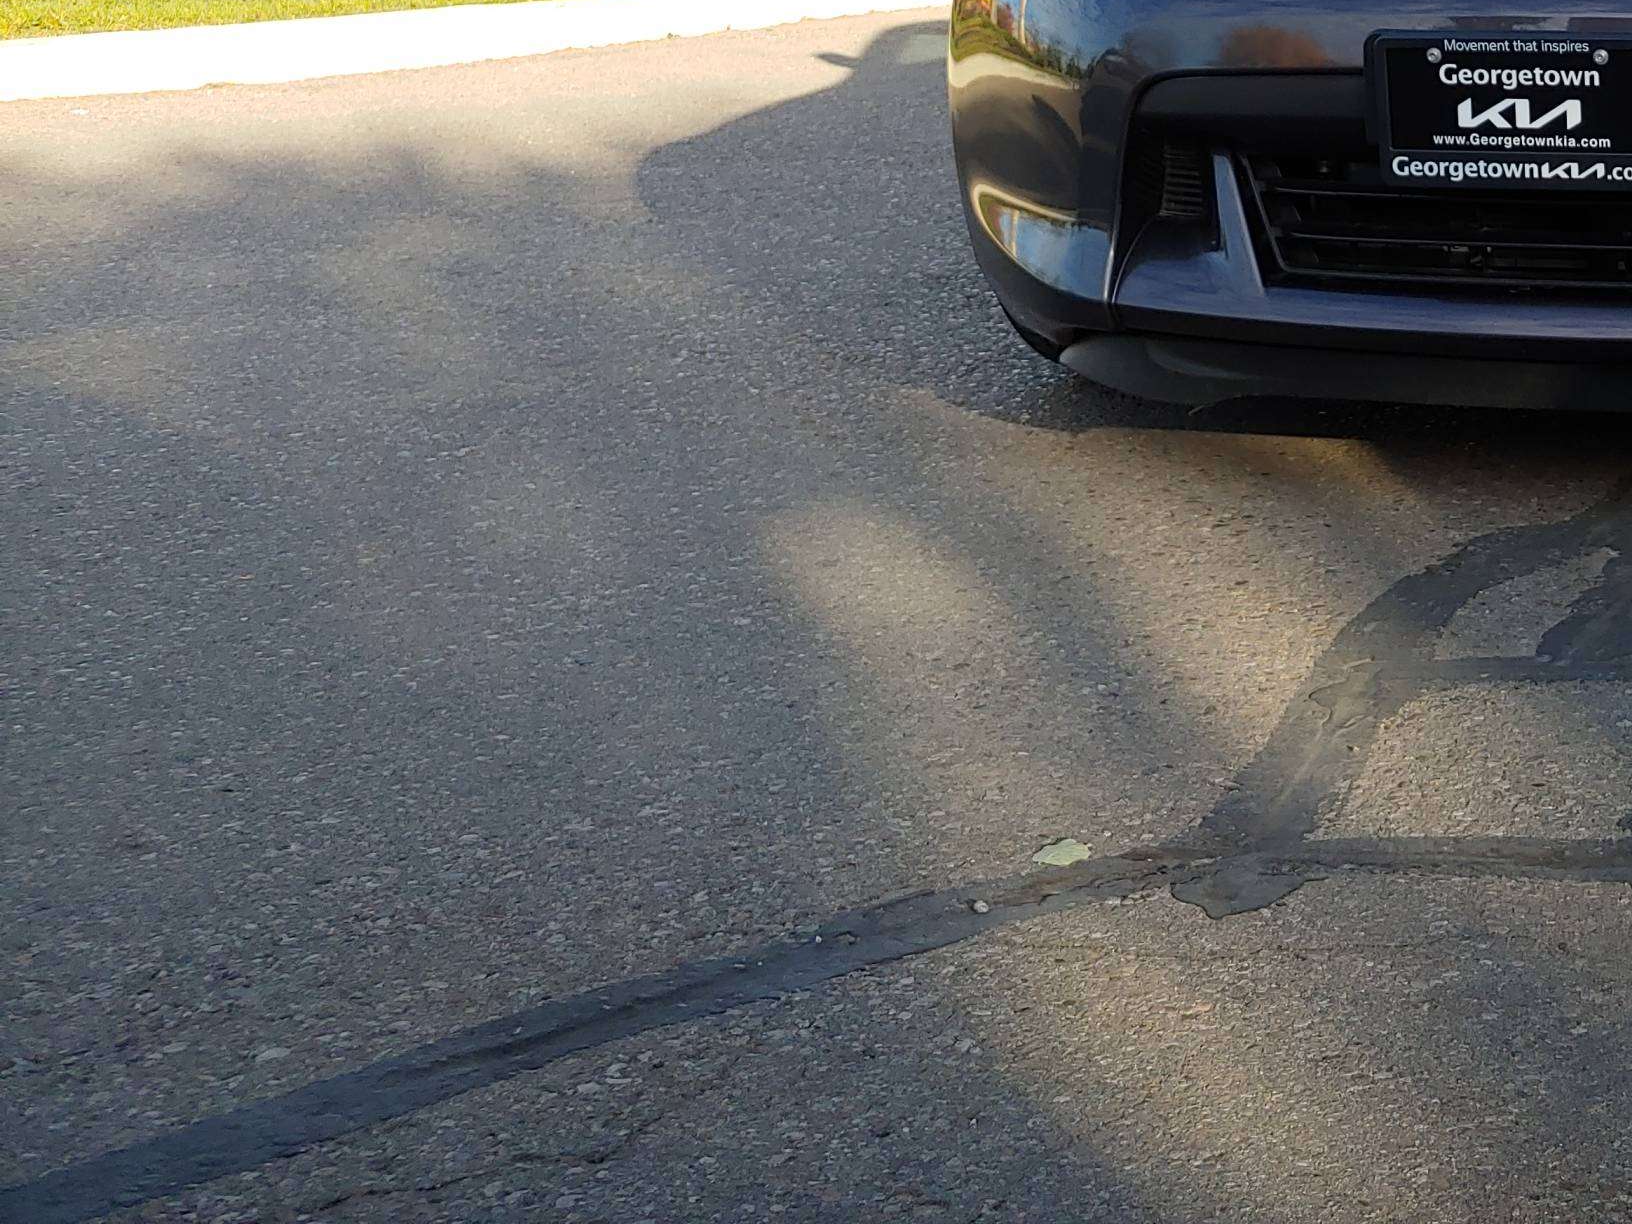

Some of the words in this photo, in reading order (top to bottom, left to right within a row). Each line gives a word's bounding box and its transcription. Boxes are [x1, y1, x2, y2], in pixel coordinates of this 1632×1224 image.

[1443, 39, 1510, 52] Movement
[1512, 39, 1537, 52] that
[1541, 40, 1589, 54] inspires
[1438, 63, 1600, 90] Georgetown
[1457, 97, 1582, 130] KIA
[1432, 132, 1611, 149] www.Georgetownkia.com
